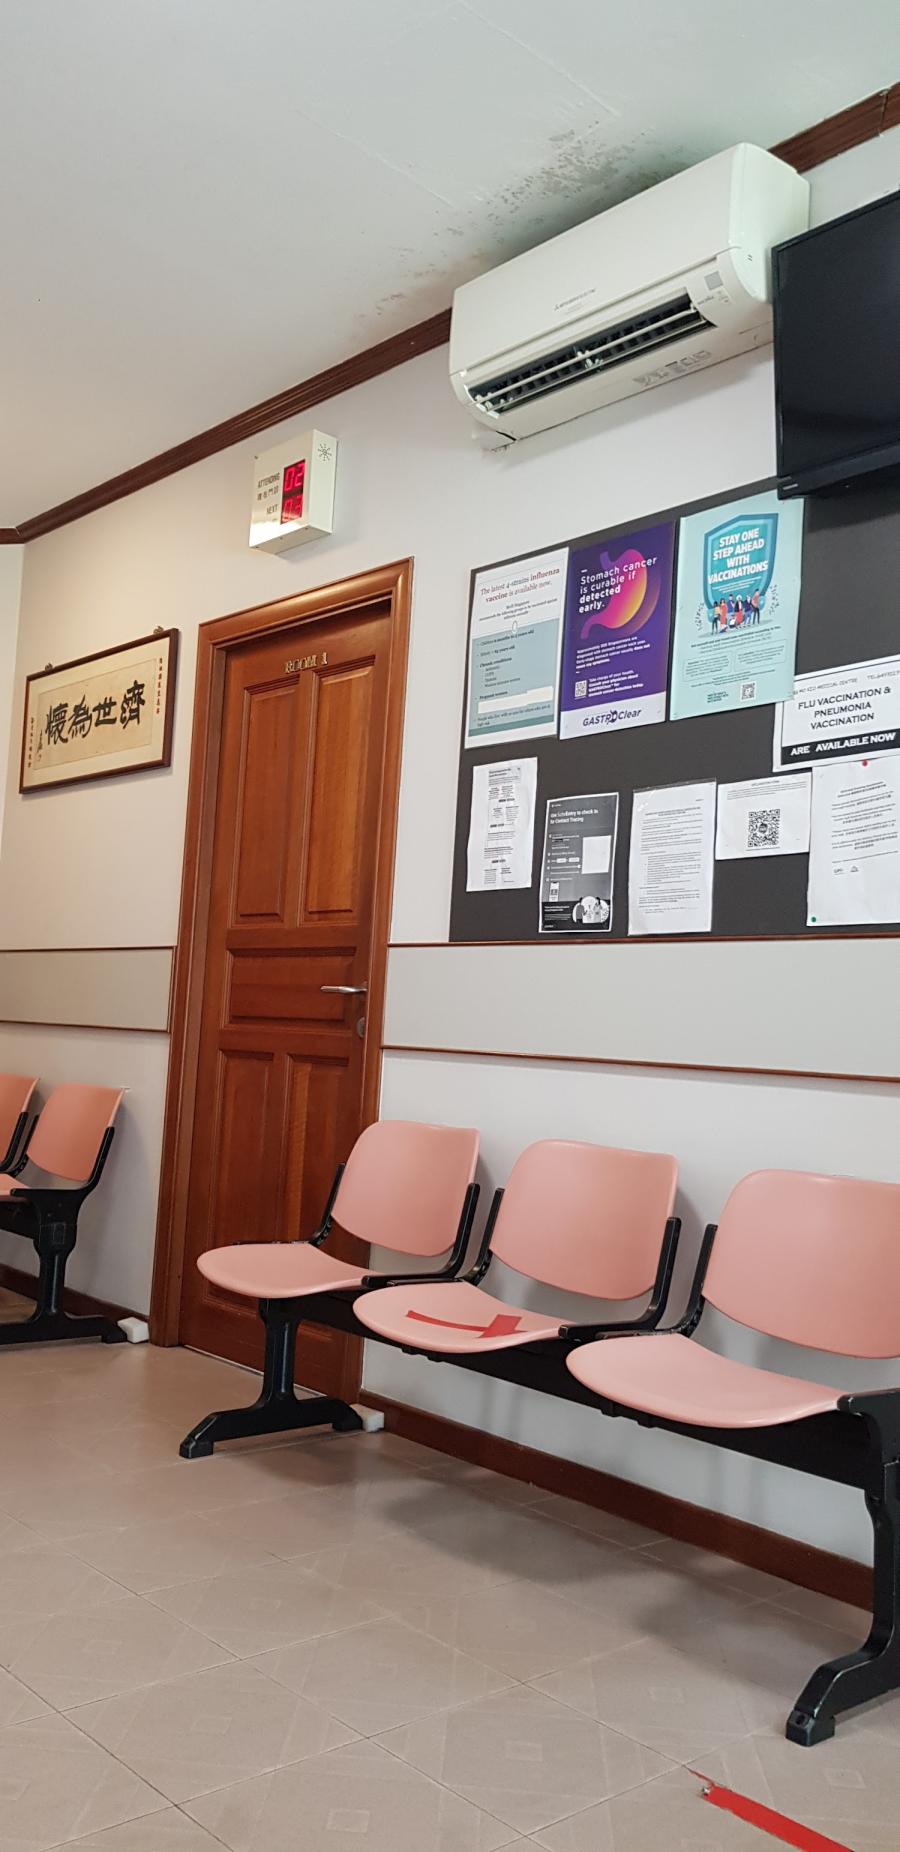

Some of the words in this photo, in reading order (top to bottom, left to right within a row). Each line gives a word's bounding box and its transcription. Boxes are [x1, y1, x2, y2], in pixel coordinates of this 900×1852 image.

[284, 462, 305, 492] 02
[720, 533, 740, 547] STAY
[742, 528, 759, 541] ONE
[713, 547, 733, 560] STEP
[735, 539, 764, 554] AHEAD
[580, 566, 620, 584] Stomach
[623, 557, 657, 572] cancer
[727, 554, 750, 568] WITH
[491, 584, 504, 592] latest
[530, 568, 560, 581] influenza
[580, 586, 587, 594] is
[590, 575, 624, 591] curable
[628, 570, 636, 580] if
[708, 560, 768, 584] VACCINATIONS
[486, 592, 508, 602] vaccine
[514, 584, 537, 595] available
[580, 584, 620, 604] detected
[579, 602, 605, 613] early.
[285, 655, 317, 673] ROOM
[321, 652, 328, 665] 1
[798, 700, 815, 710] FLU
[818, 687, 882, 706] VACCINATION
[884, 686, 891, 694] &
[814, 702, 872, 718] PNEUMONIA
[811, 713, 874, 730] VACCINATION
[790, 746, 810, 756] ARE
[816, 736, 869, 752] AVAILABLE
[870, 732, 896, 743] NOW
